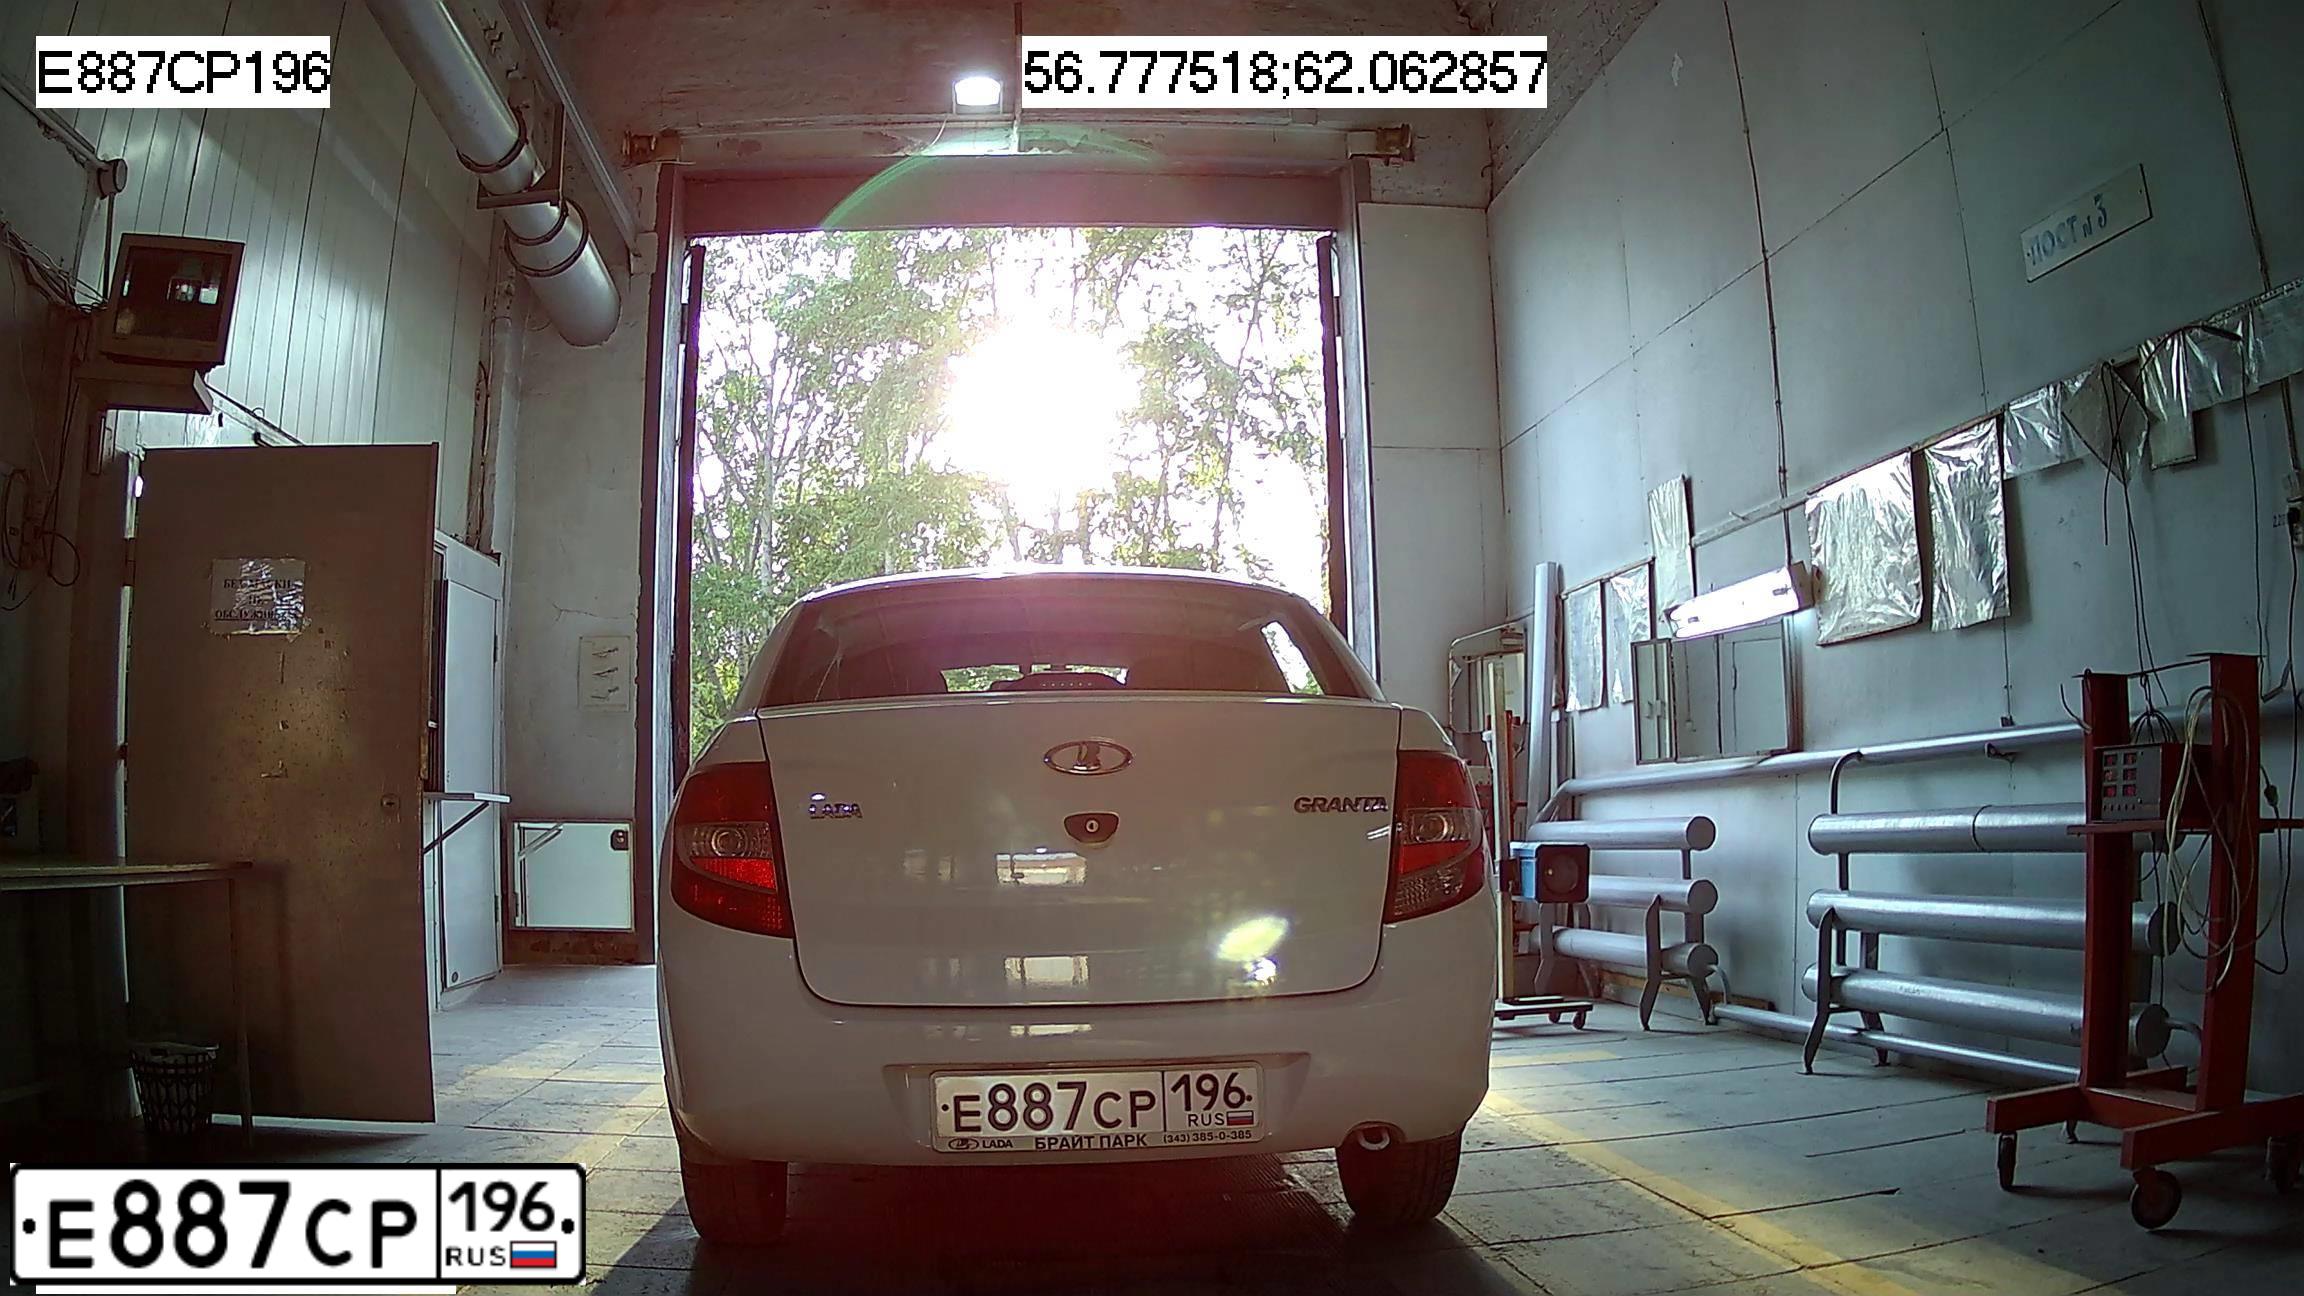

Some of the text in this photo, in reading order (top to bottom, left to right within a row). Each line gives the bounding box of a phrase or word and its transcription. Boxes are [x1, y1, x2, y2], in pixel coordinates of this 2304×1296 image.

[2030, 215, 2077, 266] ПОСТ
[1294, 796, 1388, 813] GRANTA
[953, 1073, 1246, 1132] E887CP 196
[1187, 1112, 1225, 1127] RUS
[982, 1130, 1252, 1150] LADA БРАЙТ ПАРК (343) 385-0-385
